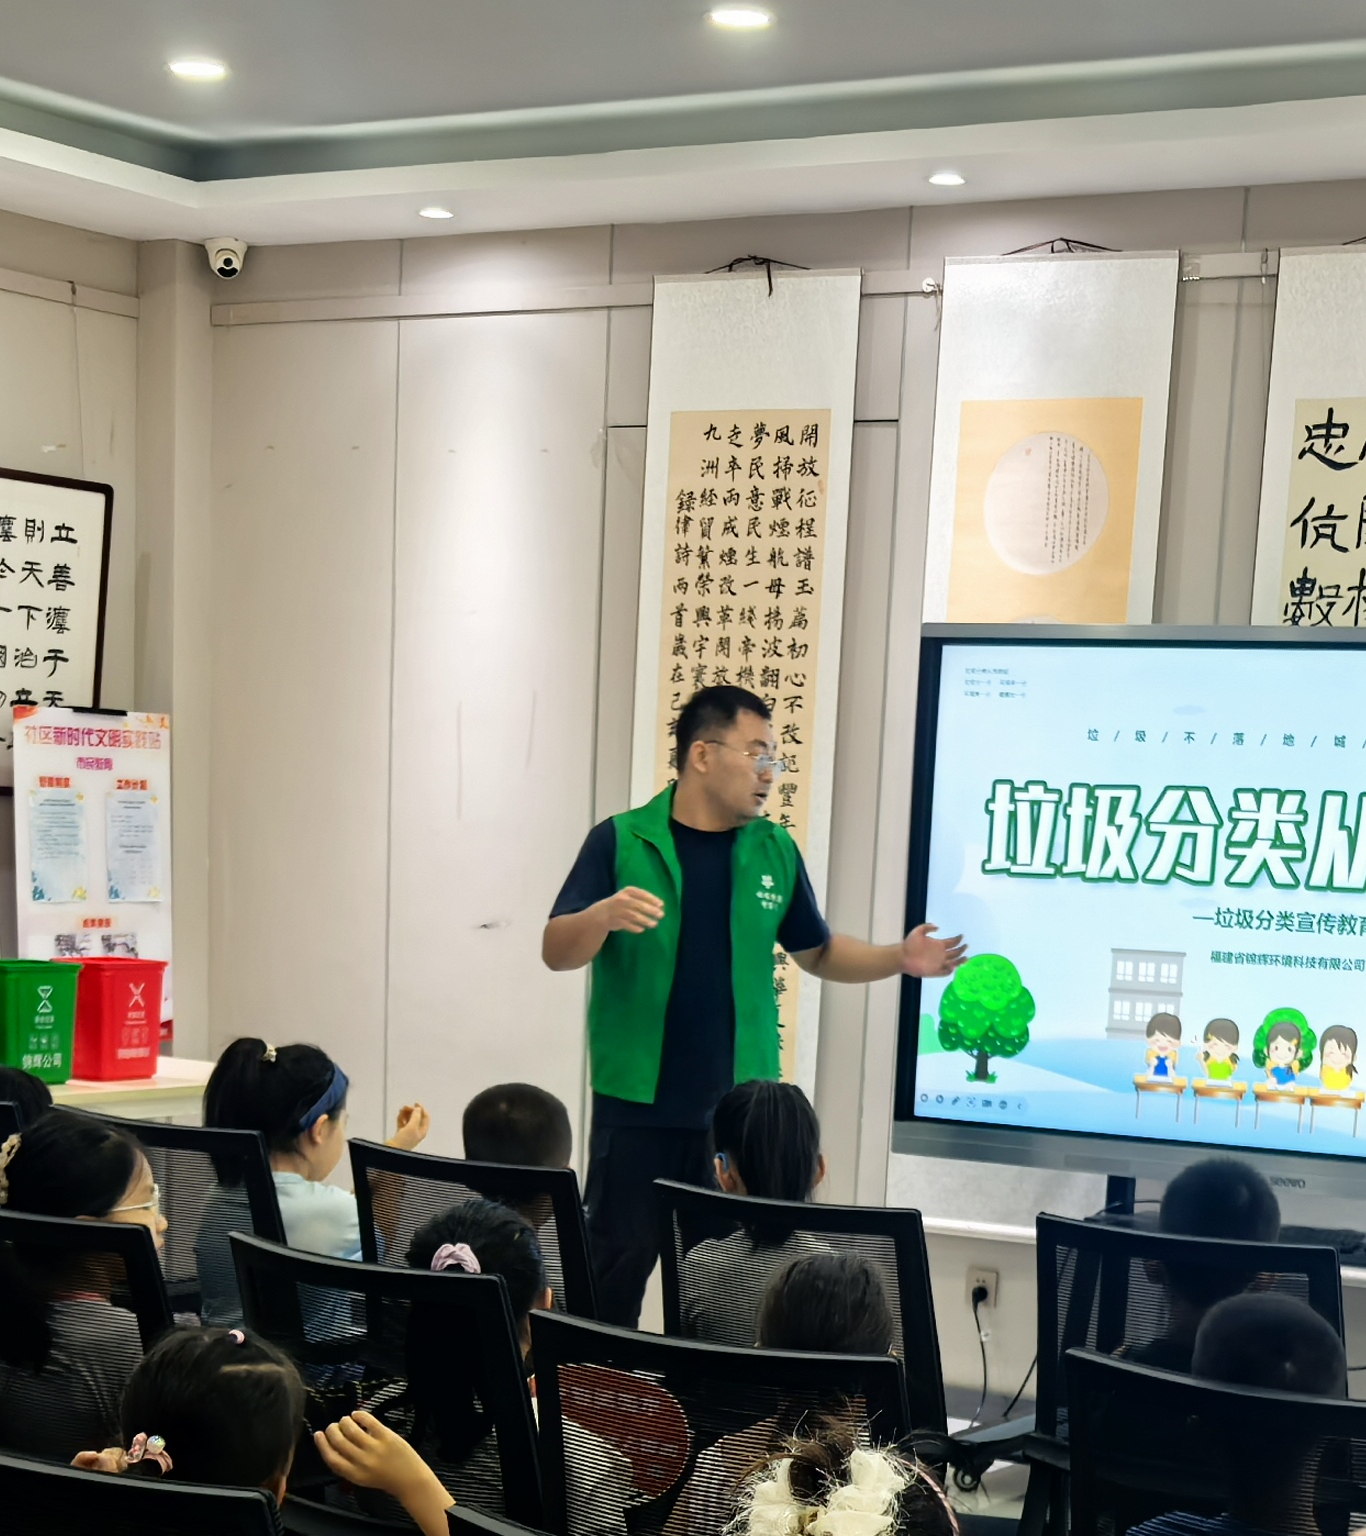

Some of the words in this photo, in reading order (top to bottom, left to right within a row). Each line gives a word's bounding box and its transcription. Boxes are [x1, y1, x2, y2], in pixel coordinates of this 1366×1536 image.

[25, 725, 161, 750] 社区新时代文明实践站
